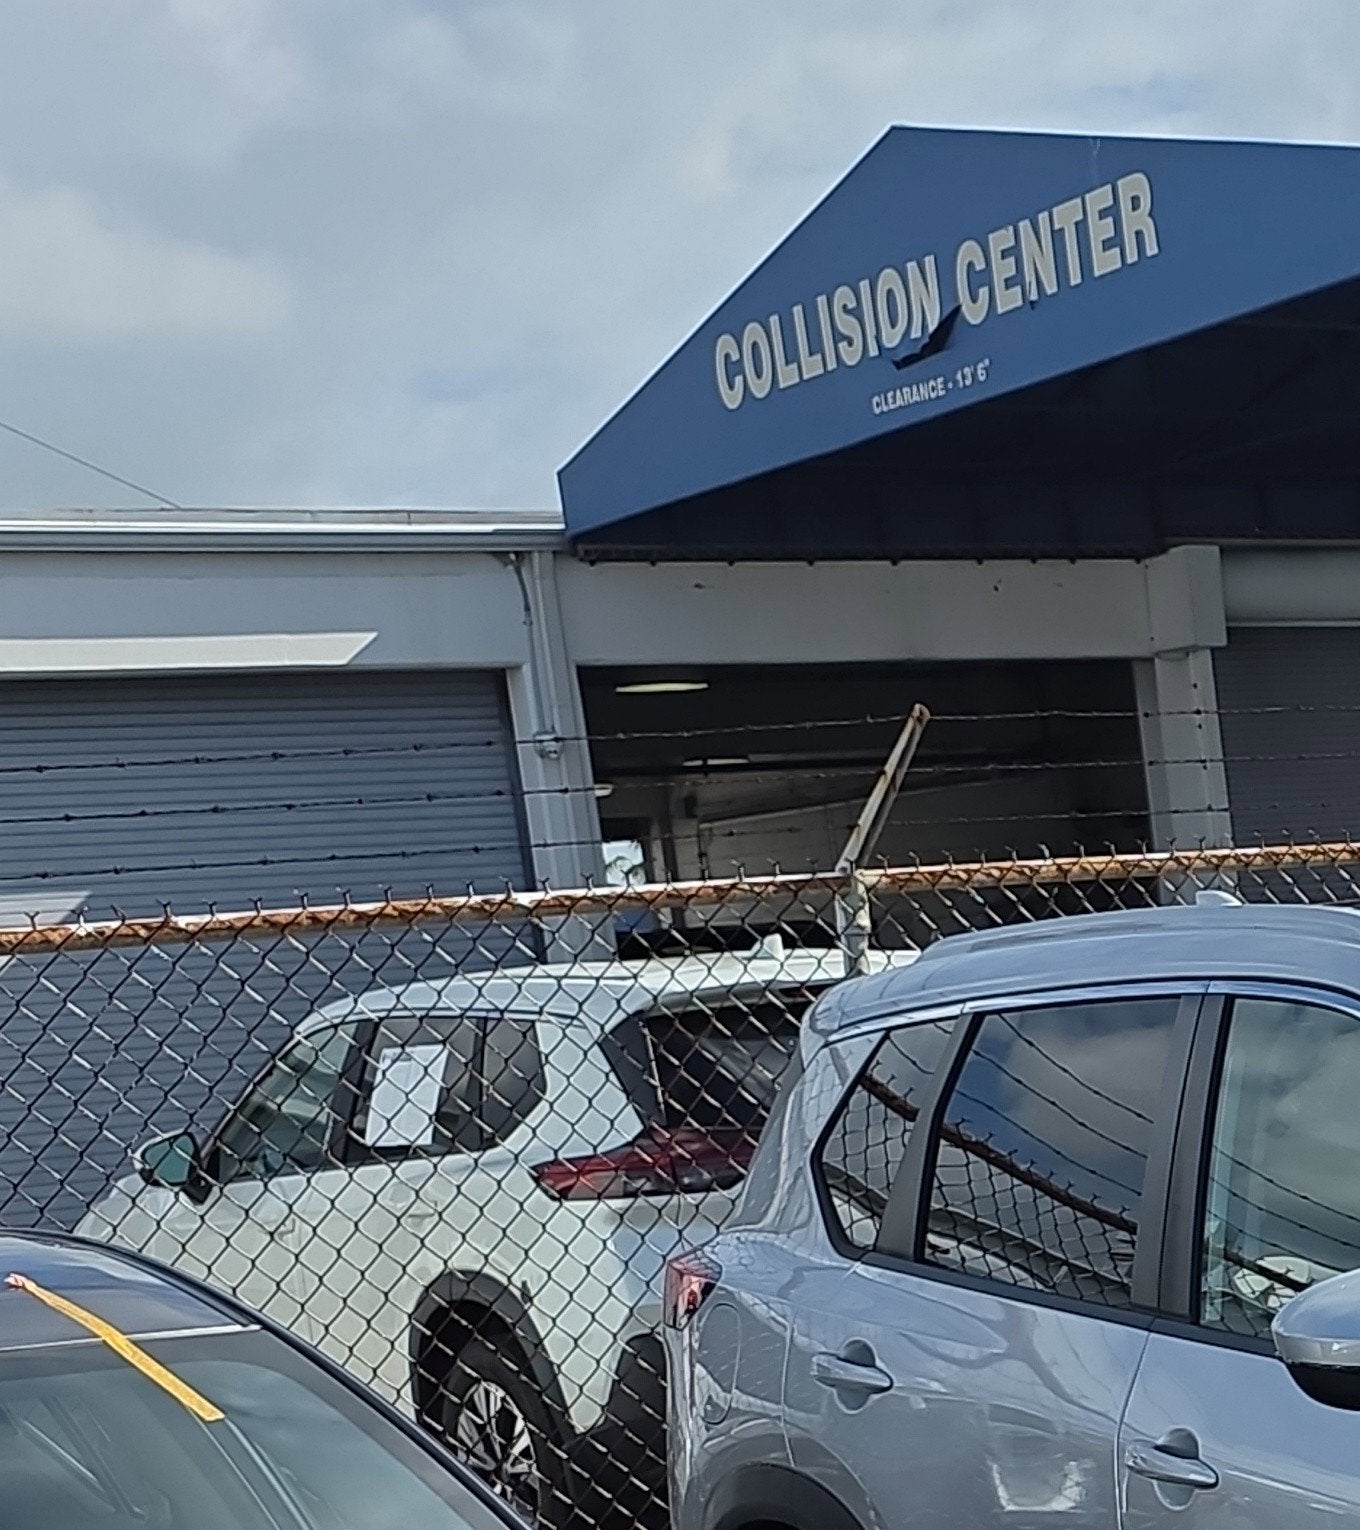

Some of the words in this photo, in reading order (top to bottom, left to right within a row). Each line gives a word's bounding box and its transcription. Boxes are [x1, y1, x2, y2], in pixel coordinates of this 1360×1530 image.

[714, 253, 941, 410] COLLISION
[955, 171, 1160, 326] CENTER
[871, 376, 946, 415] CLEARANCE
